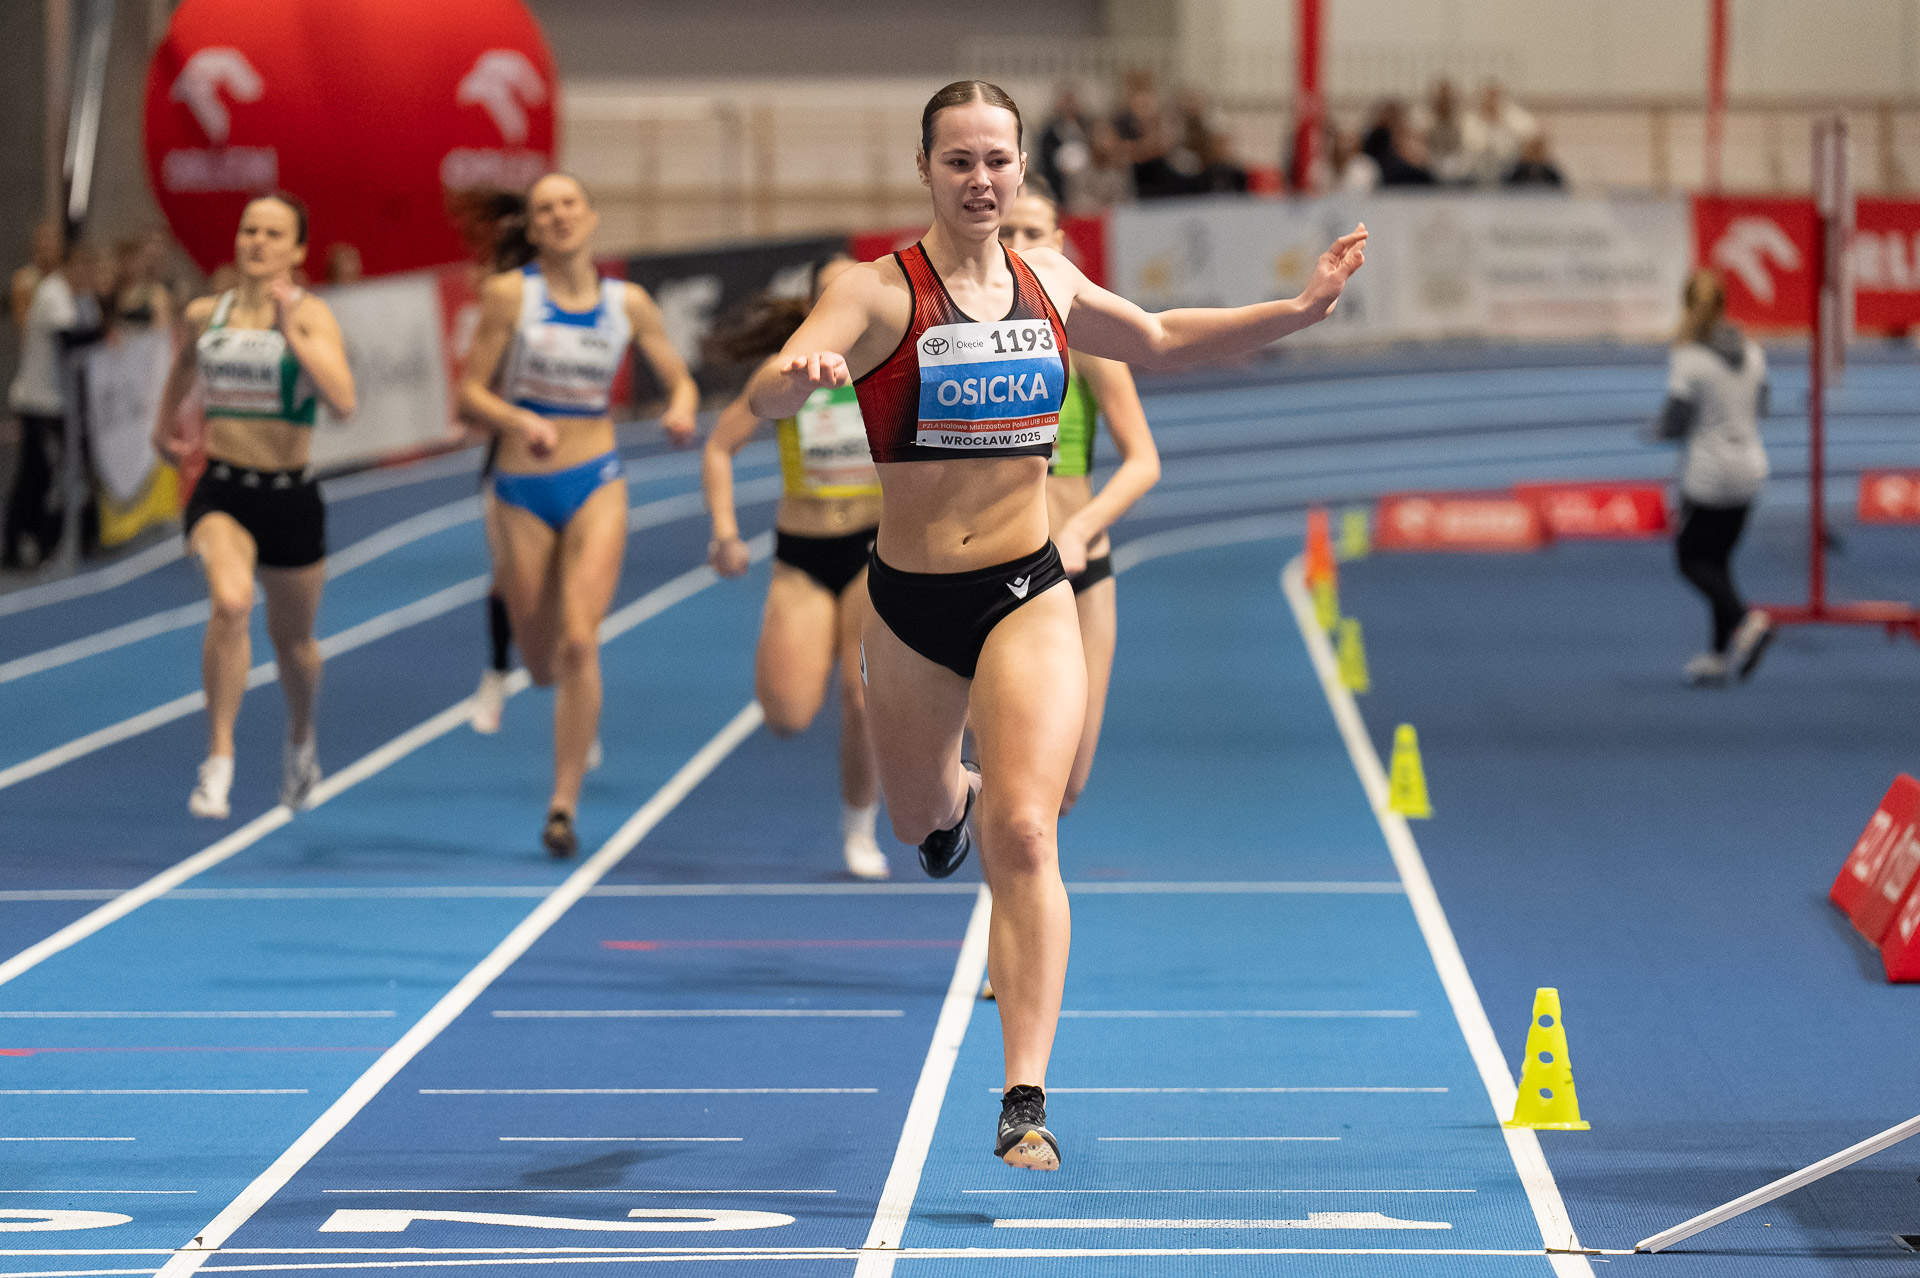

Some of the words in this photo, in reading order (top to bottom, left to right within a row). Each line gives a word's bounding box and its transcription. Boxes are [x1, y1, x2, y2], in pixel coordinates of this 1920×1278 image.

[956, 338, 984, 349] Okęcie
[990, 328, 1053, 353] 1193
[937, 372, 1049, 407] OSICKA
[940, 423, 968, 431] Halowe
[969, 423, 1011, 431] Mistrzostwa
[1012, 420, 1029, 429] Polski
[1044, 416, 1056, 424] U20
[940, 434, 1012, 446] WROCŁAW
[1014, 432, 1041, 444] 2025
[319, 1208, 796, 1232] 2
[992, 1212, 1452, 1230] 1
